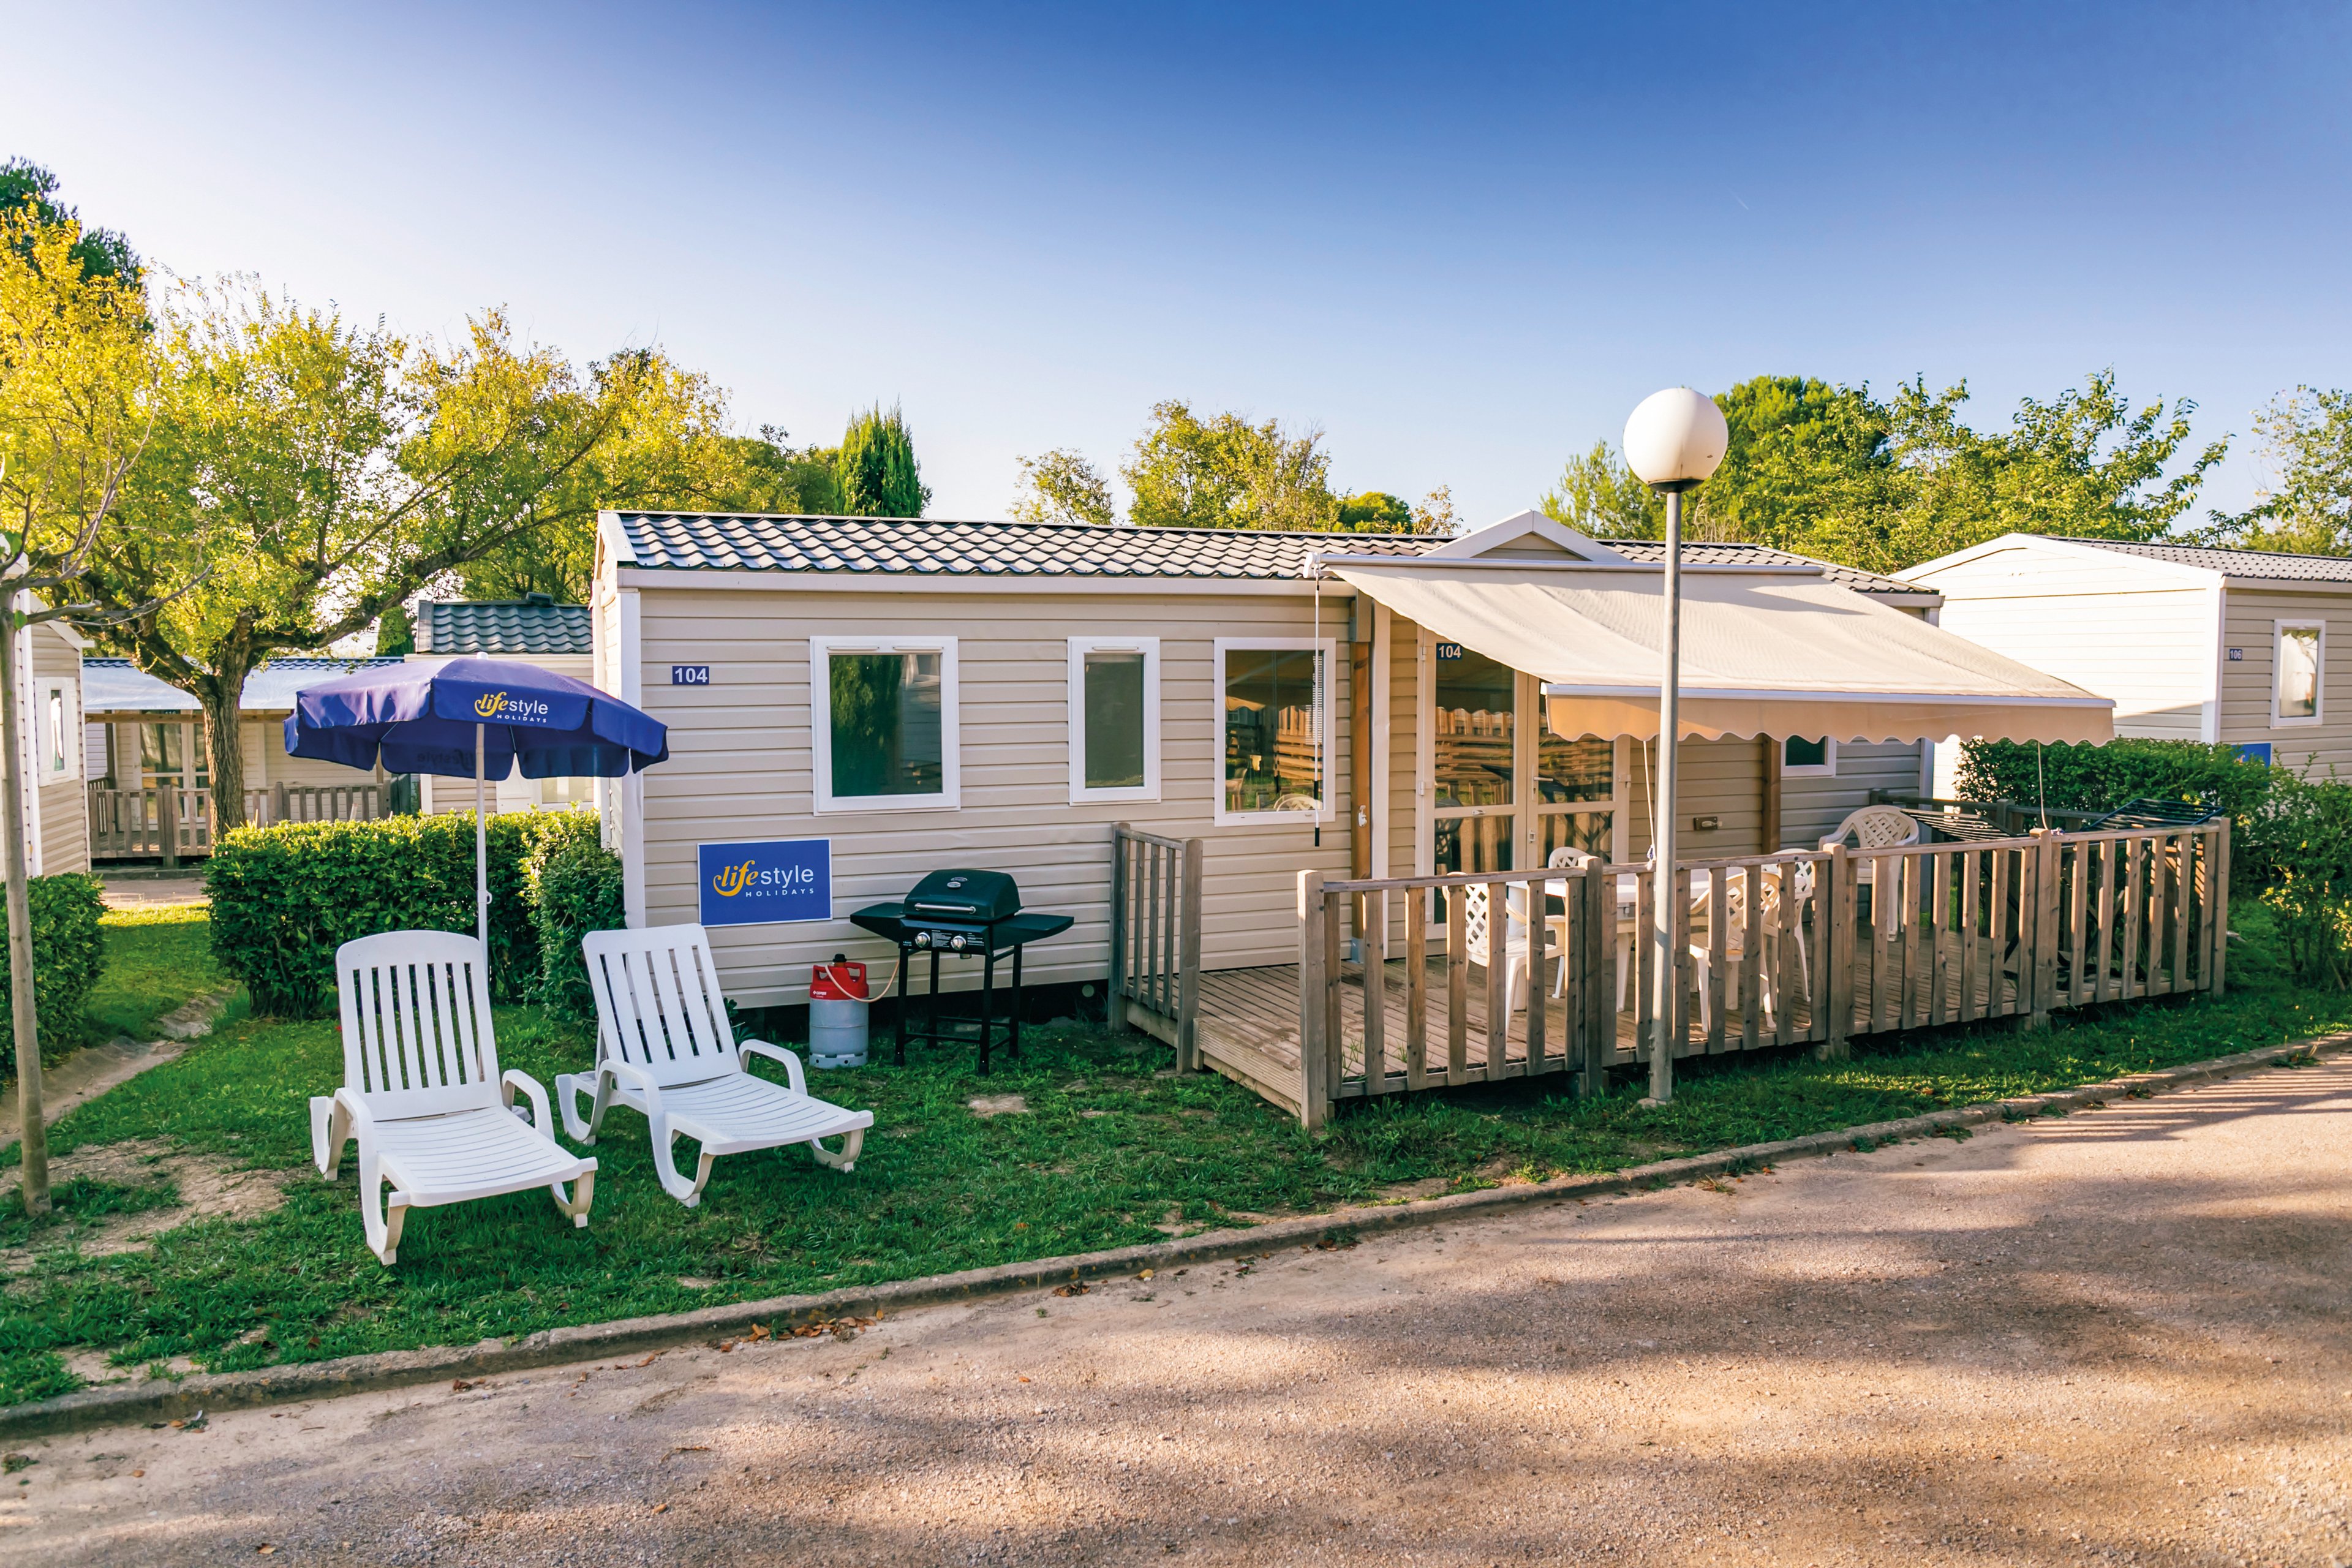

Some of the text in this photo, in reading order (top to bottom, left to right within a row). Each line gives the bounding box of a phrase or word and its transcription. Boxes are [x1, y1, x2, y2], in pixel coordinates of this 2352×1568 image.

[1439, 645, 1461, 658] 104
[2230, 649, 2242, 660] 106
[674, 667, 708, 683] 104
[474, 692, 548, 717] lifestyle
[497, 714, 547, 723] HOLIDAYS
[712, 859, 814, 897] lifestyle
[745, 888, 814, 897] HOLIDAYS
